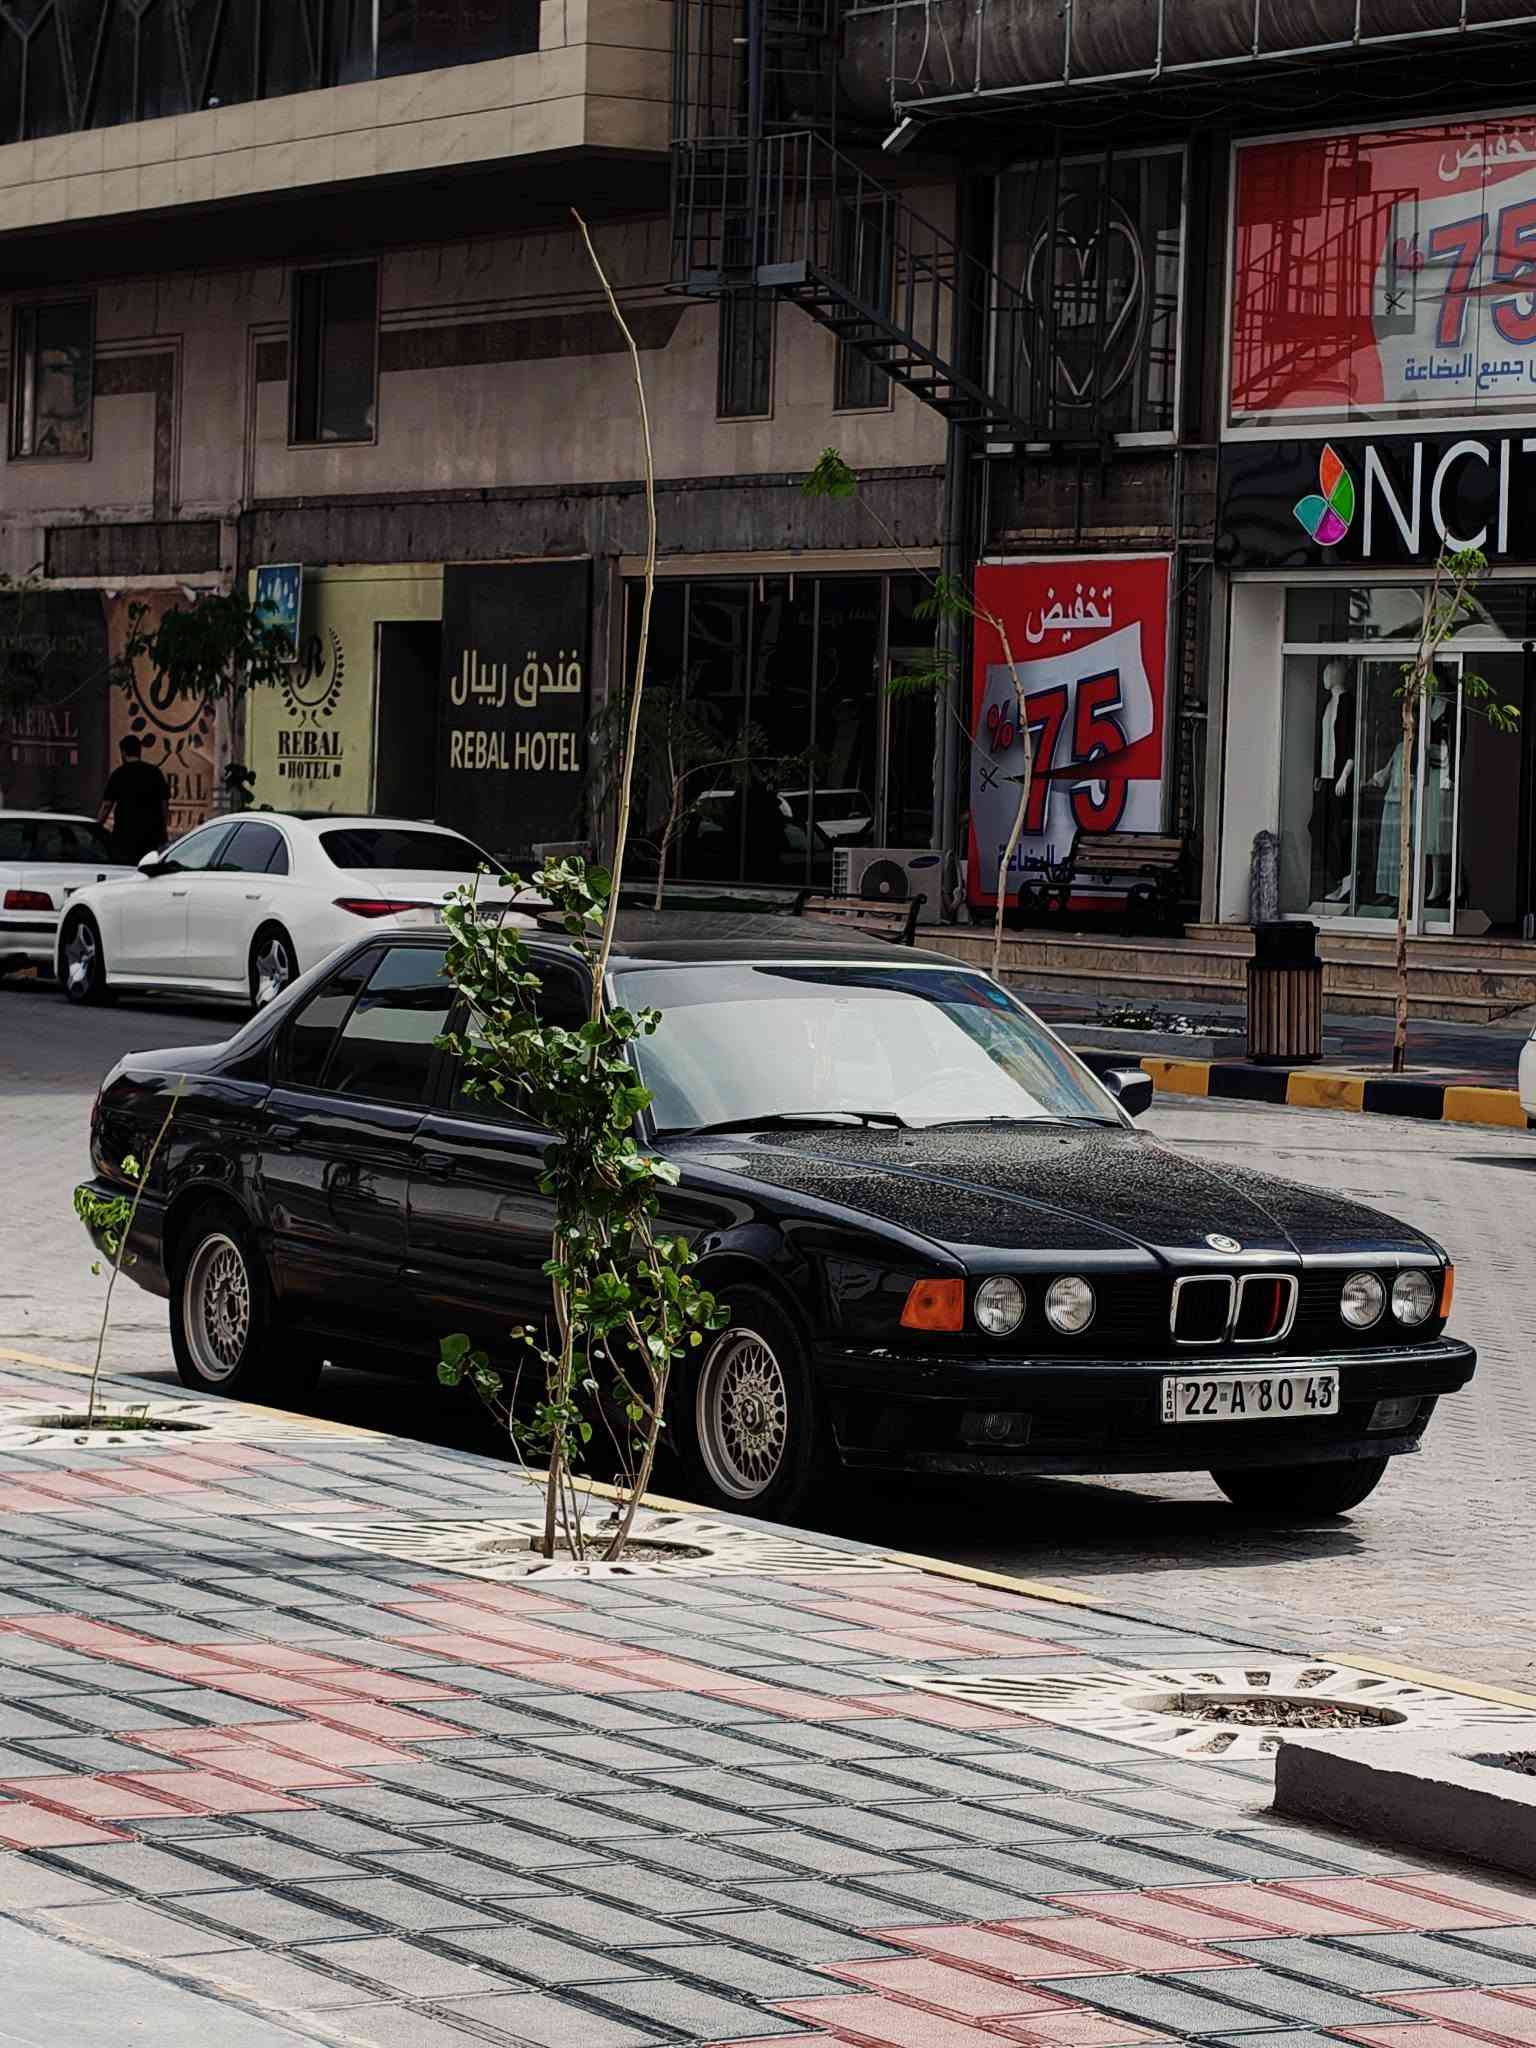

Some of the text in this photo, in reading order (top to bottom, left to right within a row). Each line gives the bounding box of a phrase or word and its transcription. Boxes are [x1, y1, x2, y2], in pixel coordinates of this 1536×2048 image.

[1404, 352, 1473, 385] البضاعة
[1478, 360, 1524, 390] جميع
[1025, 583, 1113, 645] تخفيض
[450, 648, 581, 709] فندق ريبال
[279, 731, 343, 756] REBAL
[450, 730, 580, 773] REBAL HOTEL
[288, 761, 330, 780] HOTEL
[167, 774, 206, 801] BAL
[1186, 1381, 1217, 1415] 22
[1231, 1380, 1246, 1413] A
